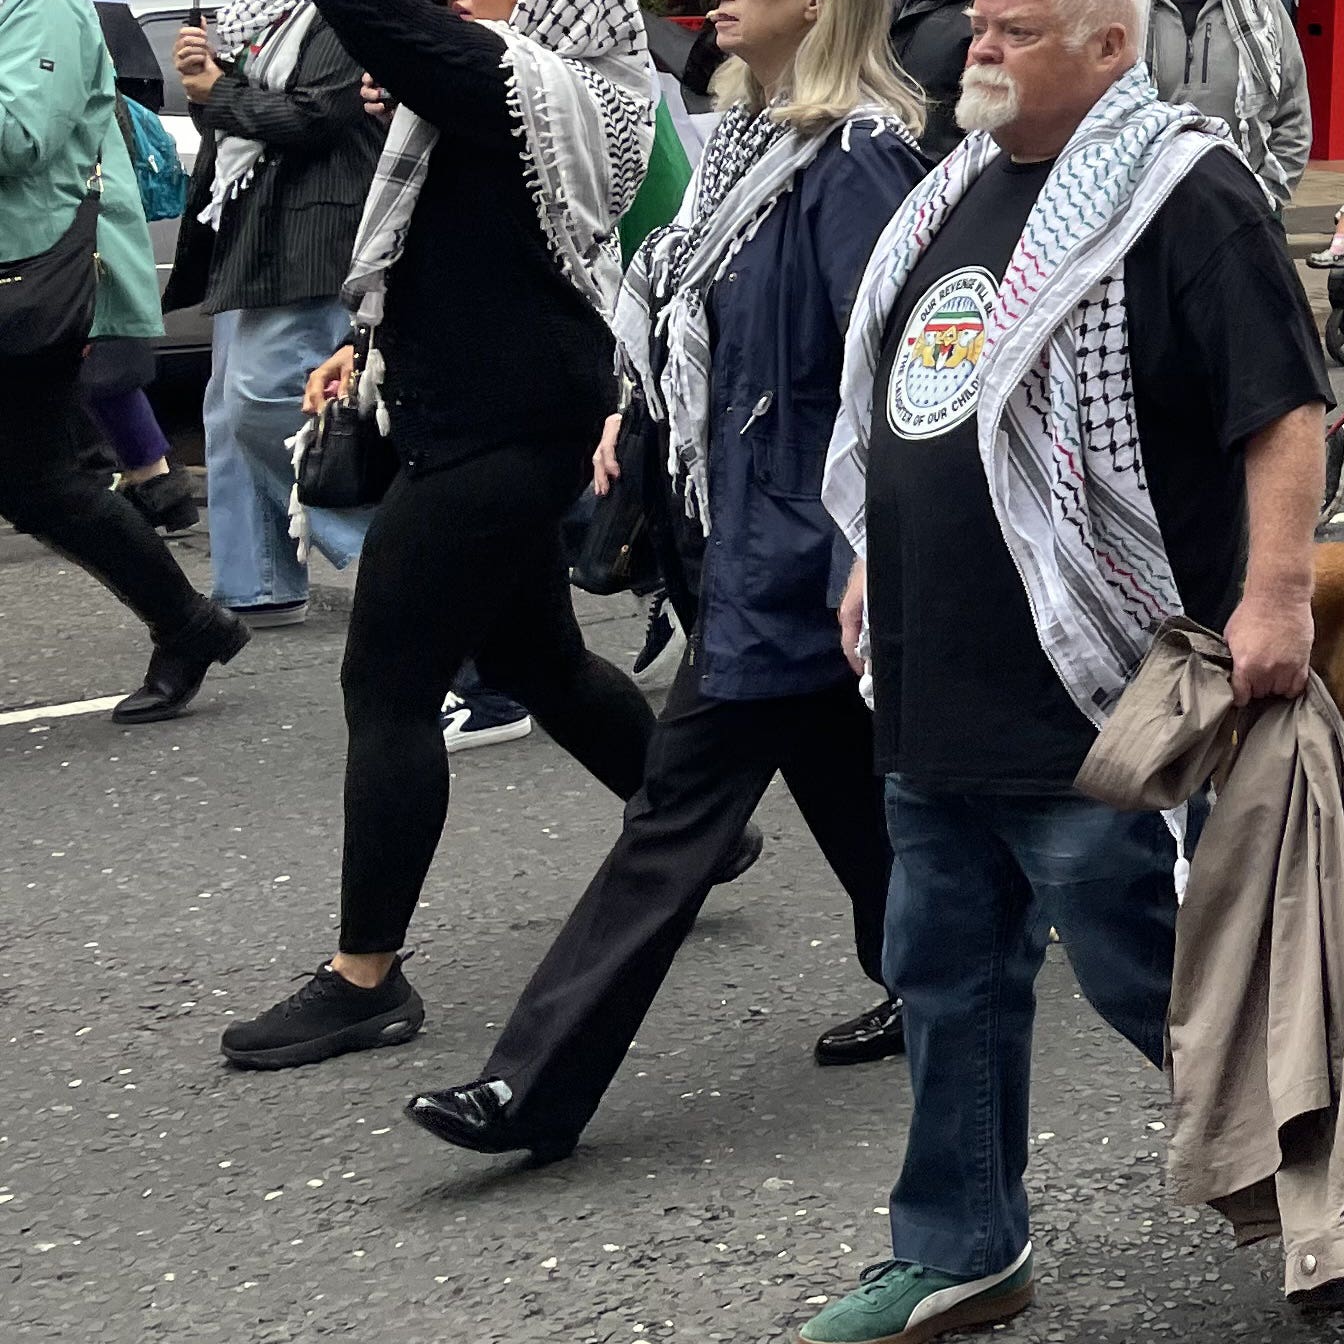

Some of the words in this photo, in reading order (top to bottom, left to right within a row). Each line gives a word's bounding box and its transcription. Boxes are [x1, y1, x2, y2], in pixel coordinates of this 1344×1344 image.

[920, 298, 937, 322] OUR
[912, 414, 926, 427] OF
[927, 407, 948, 425] OUR
[951, 373, 980, 412] CHILD
